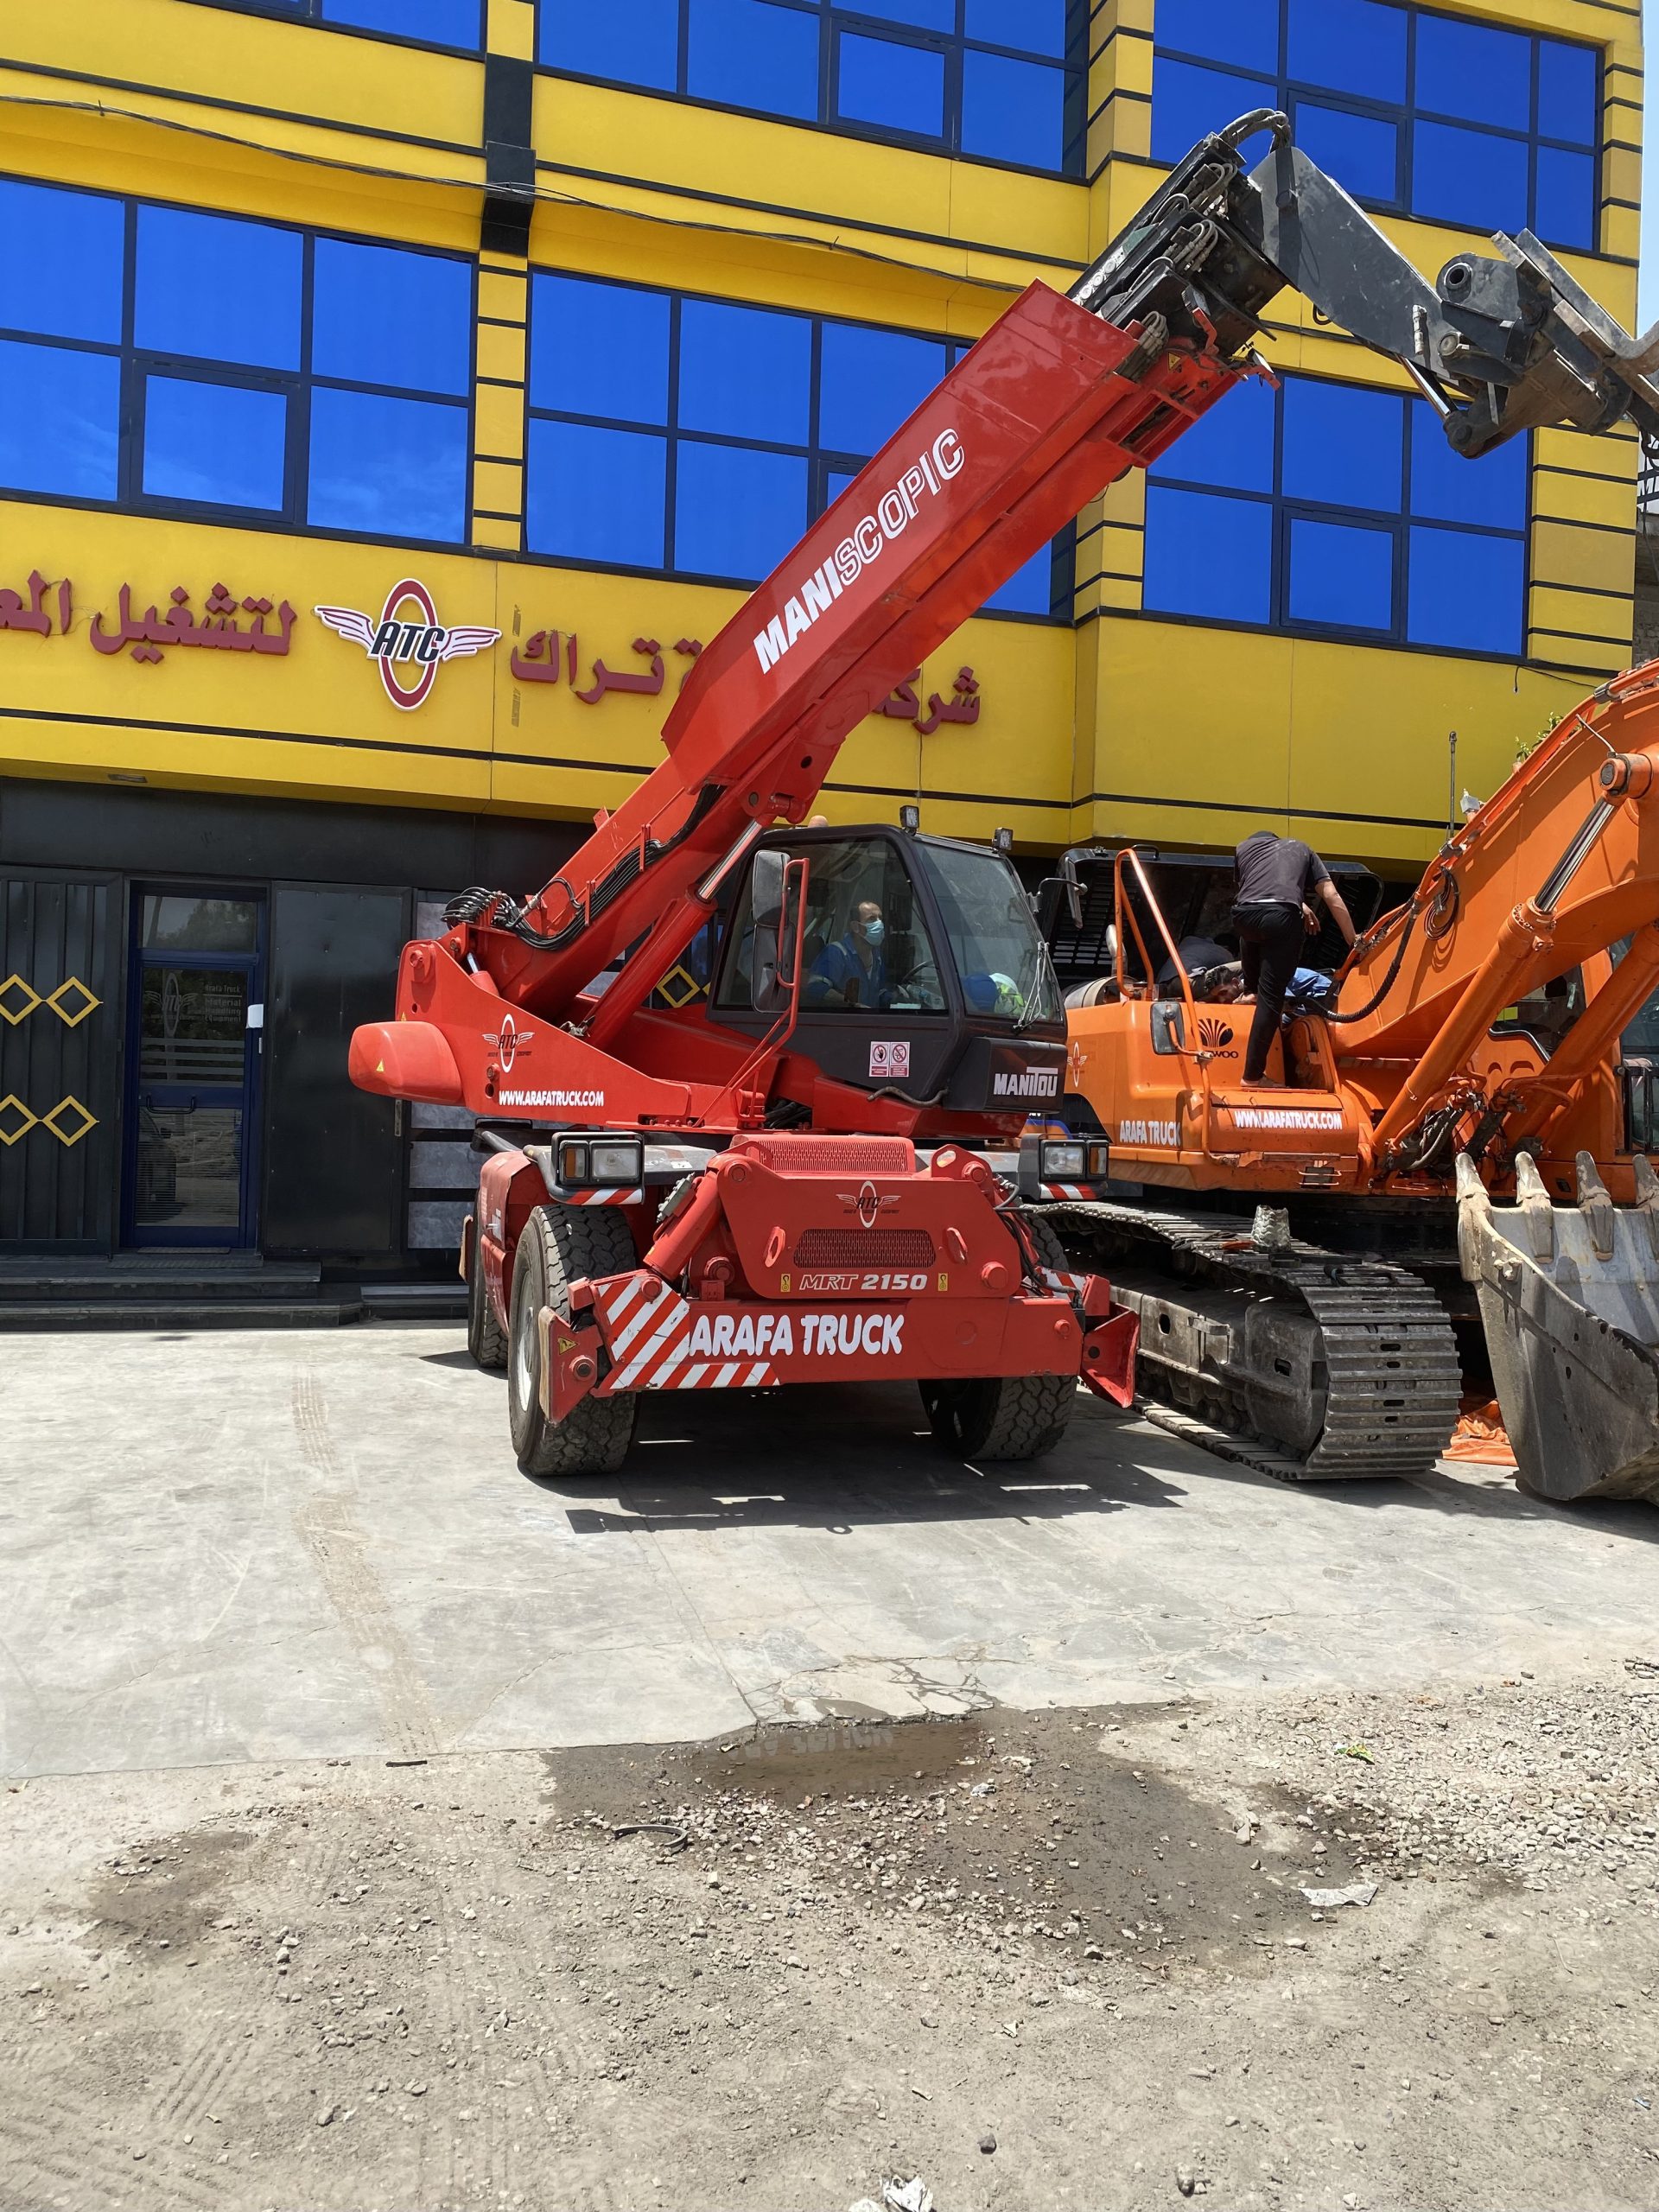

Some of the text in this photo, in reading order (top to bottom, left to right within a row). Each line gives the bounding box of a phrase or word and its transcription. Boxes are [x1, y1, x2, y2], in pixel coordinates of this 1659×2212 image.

[753, 428, 965, 675] MANISCOPIC
[89, 581, 298, 664] لتشغيل
[368, 620, 447, 664] ATC
[863, 665, 981, 735] شرك
[499, 1034, 518, 1049] ATC
[993, 1066, 1058, 1097] MANITOU
[499, 1090, 604, 1107] WWW.ARAFATRUCK.COM
[1119, 1120, 1181, 1146] ARAFA TRUCK
[1234, 1110, 1343, 1130] WWW.ARAFATRUCK.COM
[856, 1197, 880, 1209] ATC
[798, 1274, 928, 1291] MRT 2150
[689, 1313, 905, 1357] ARAFA TRUCK
